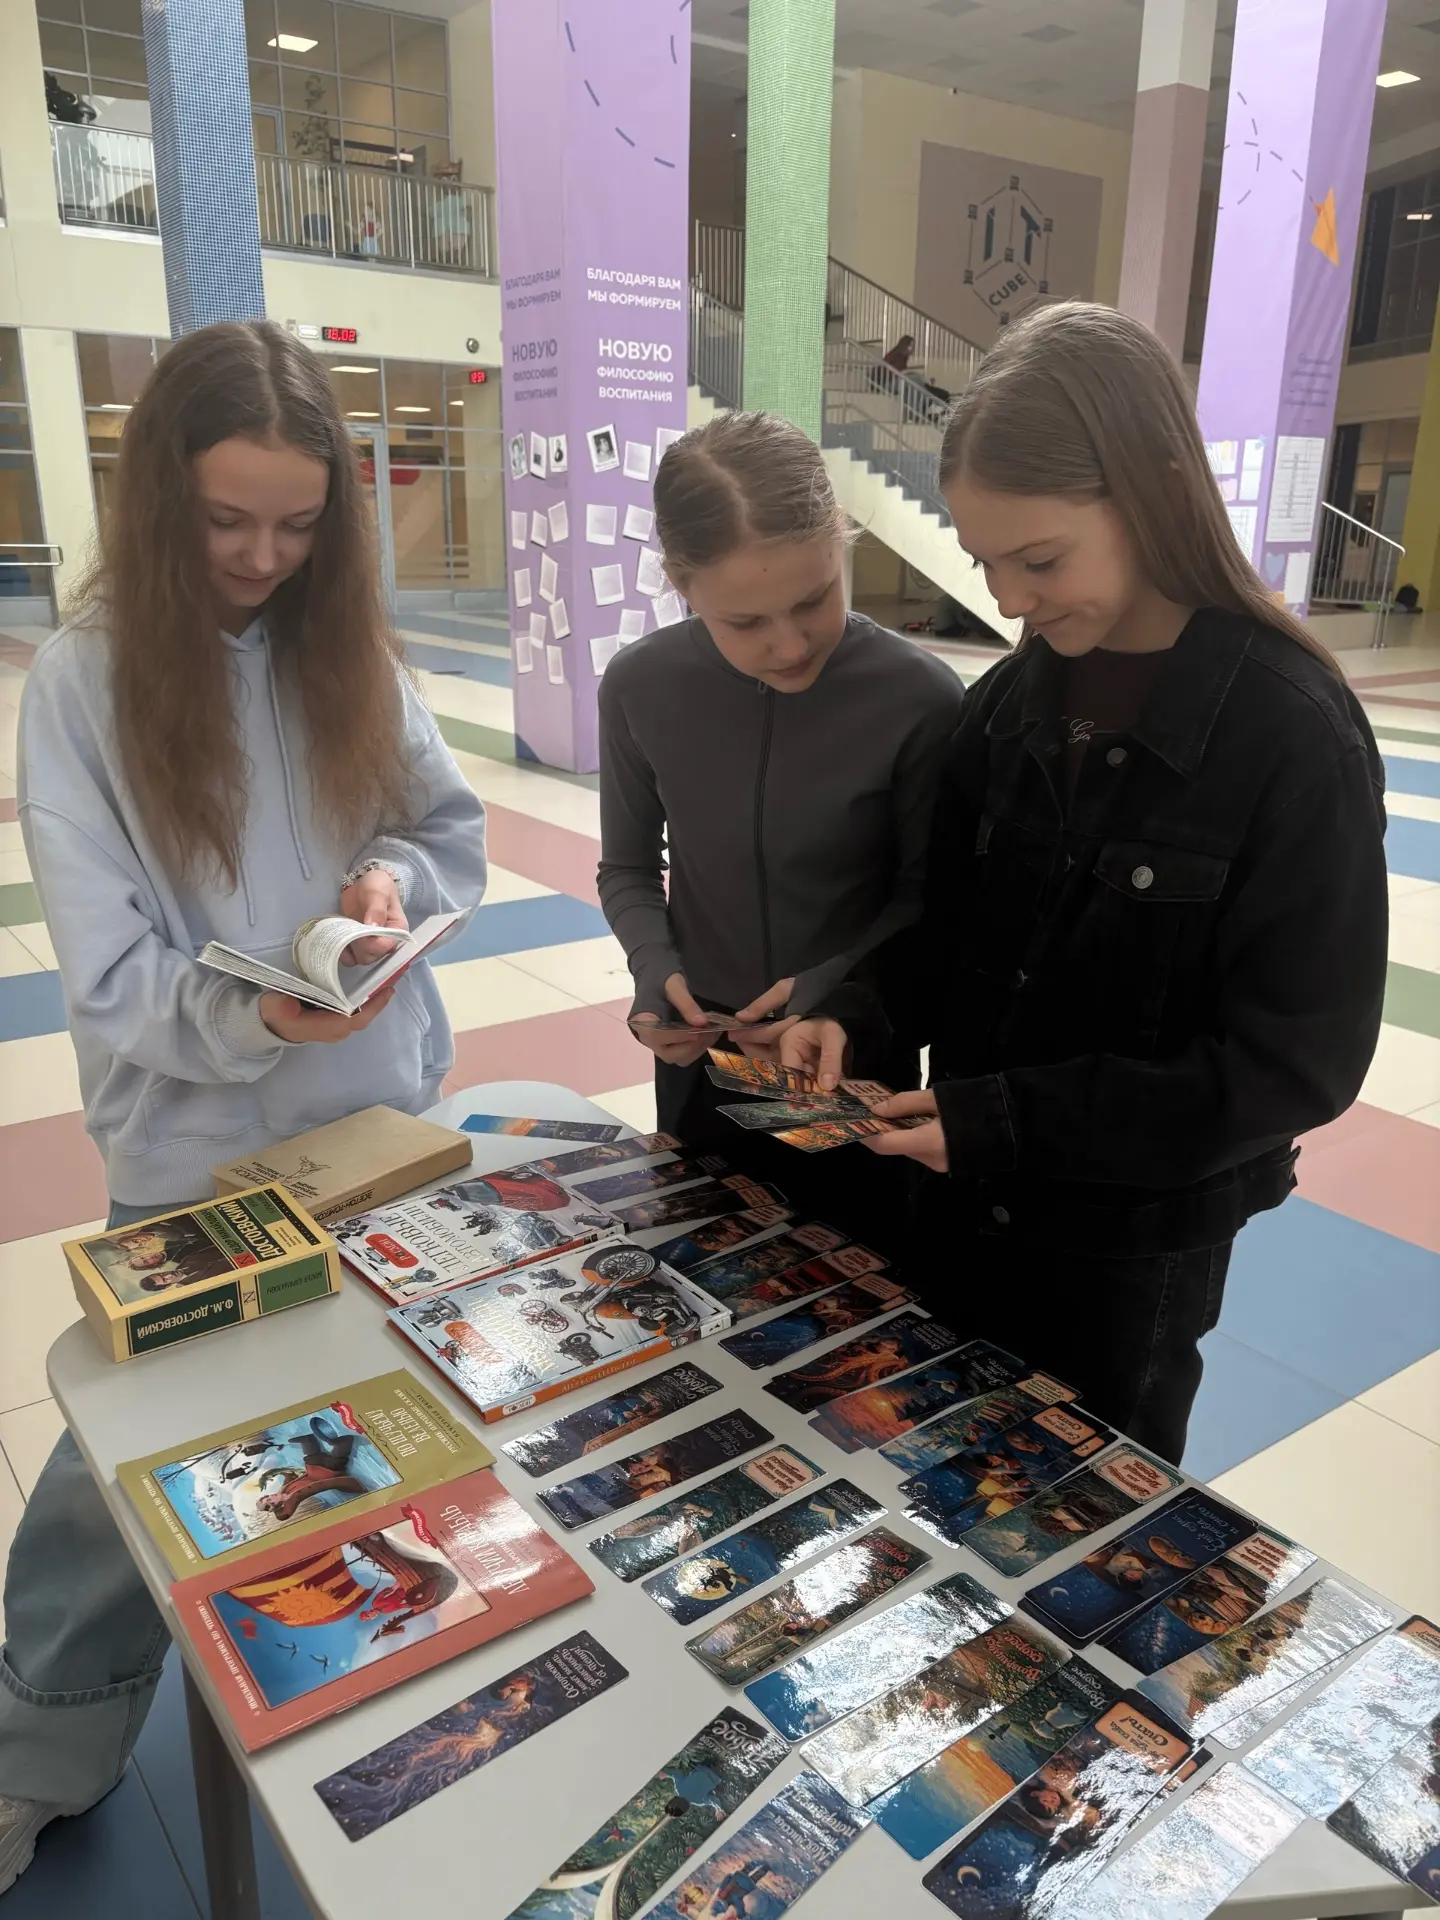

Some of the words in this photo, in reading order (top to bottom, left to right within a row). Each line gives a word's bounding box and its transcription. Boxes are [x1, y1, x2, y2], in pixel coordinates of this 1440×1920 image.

[586, 267, 656, 287] БЛАГОДАРЯ
[657, 276, 681, 290] ВАМ
[988, 273, 1028, 307] CUBE
[587, 290, 608, 302] МЫ
[609, 291, 681, 311] ФОРМИРУЕМ
[512, 339, 557, 362] НОВУЮ
[599, 338, 672, 363] НОВУЮ
[597, 366, 673, 383] ФИЛОСОФИЮ
[599, 386, 673, 402] ВОСПИТАНИЯ
[218, 1200, 283, 1258] ДОСТОЕВСКИЙ
[403, 1205, 488, 1264] АВТОМОБИЛИ
[379, 1211, 469, 1272] ЛЕГКОВЫЕ
[210, 1298, 232, 1313] Ф.М.
[136, 1304, 208, 1339] ДОСТОЕВСКИЙ
[393, 1388, 413, 1405] СКАЗКИ
[365, 1408, 407, 1445] ЩУЧЬЕМУ
[389, 1406, 431, 1443] ВЕЛЕНЬЮ
[411, 1405, 437, 1430] НАРОДНЫЕ
[396, 1441, 417, 1457] ПО
[434, 1431, 457, 1453] РУССКИЕ
[1170, 1512, 1197, 1532] одна
[1186, 1503, 1229, 1527] спать!
[1196, 1516, 1228, 1539] глава
[1195, 1531, 1226, 1553] Ещё
[197, 1605, 215, 1629] ЧТЕНИЮ
[210, 1629, 220, 1639] ПО
[215, 1640, 239, 1674] ПРОГРАММА
[984, 1635, 1040, 1680] Возвращайся
[1004, 1635, 1044, 1662] скорее
[552, 1653, 572, 1674] вызвать
[561, 1647, 602, 1685] зависимость
[594, 1669, 607, 1677] от
[544, 1658, 580, 1698] Осторожно,
[569, 1674, 591, 1689] может
[1071, 1665, 1101, 1689] скорее
[234, 1674, 259, 1709] ШКОЛЬНАЯ
[1108, 1720, 1130, 1738] глава
[1119, 1715, 1169, 1747] Спать!
[773, 1814, 807, 1843] миссия
[803, 1840, 831, 1861] Моя
